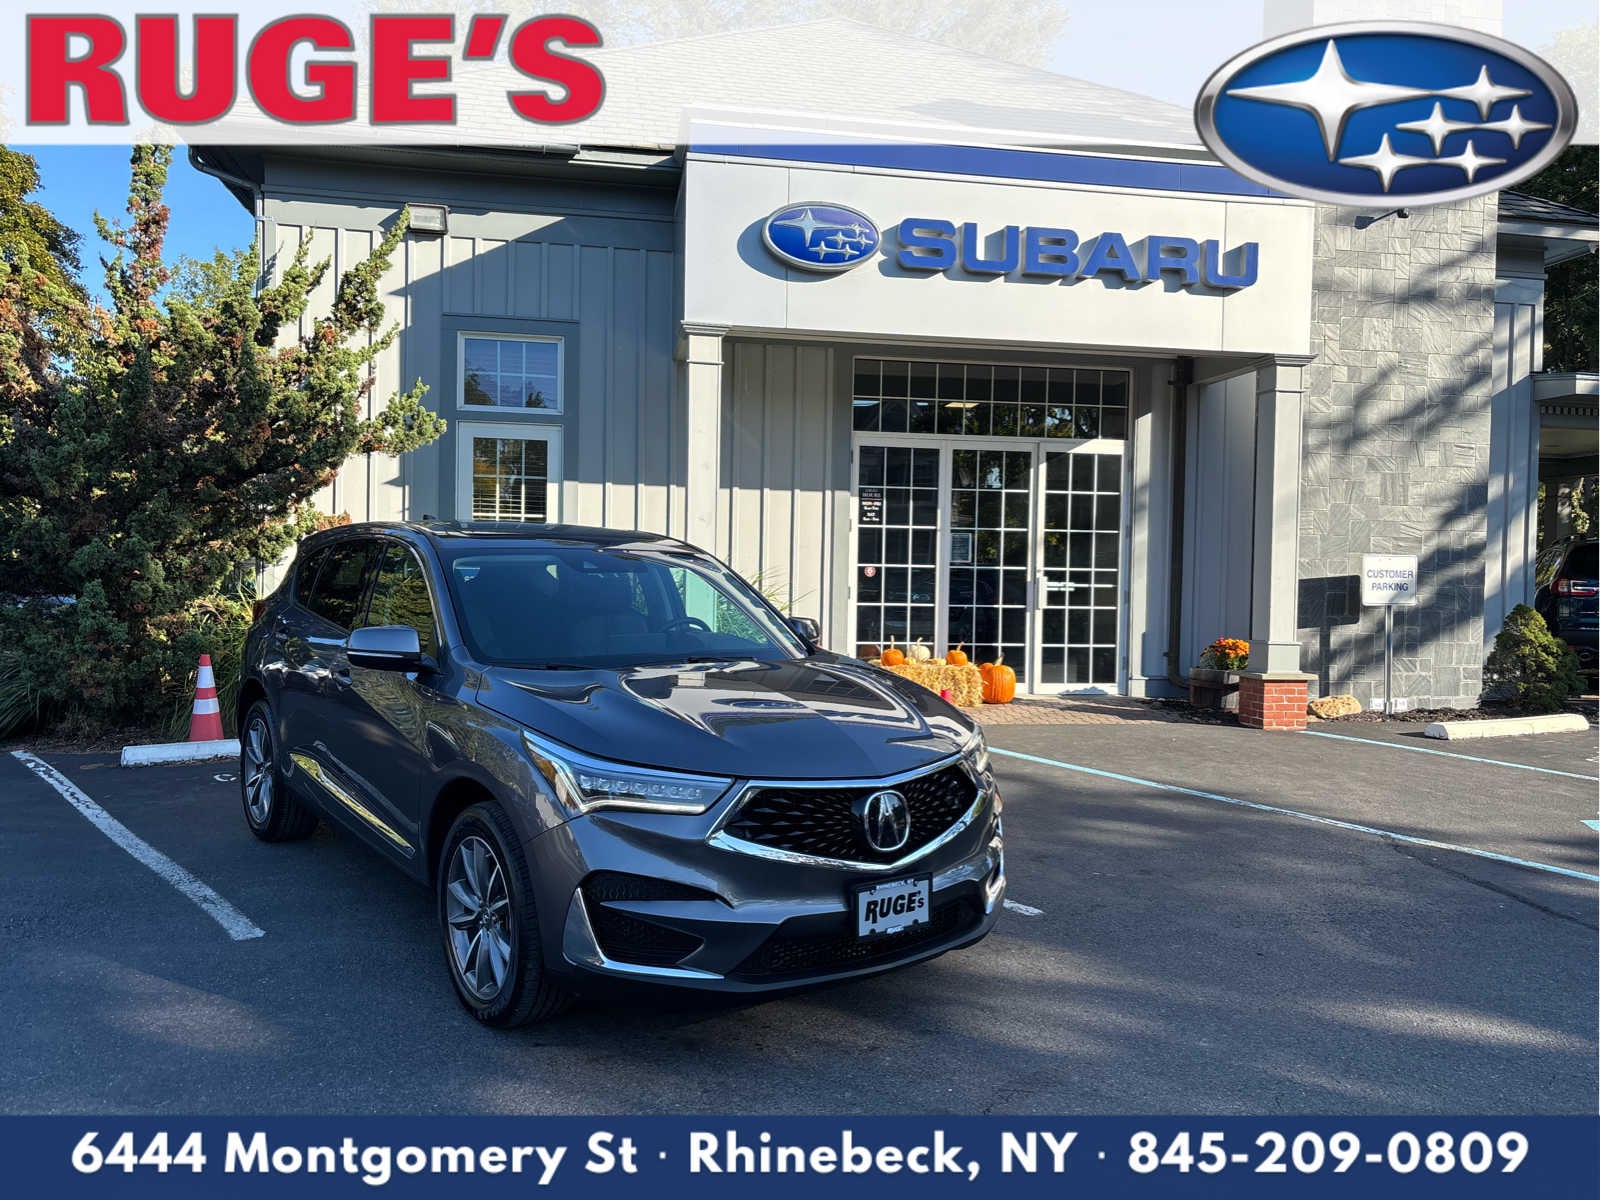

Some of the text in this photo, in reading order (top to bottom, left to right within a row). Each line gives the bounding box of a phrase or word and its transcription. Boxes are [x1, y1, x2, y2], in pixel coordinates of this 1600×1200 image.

[899, 217, 1259, 289] SUBARU
[1366, 569, 1414, 579] CUSTOMER
[1371, 582, 1409, 592] PARKING
[864, 890, 925, 925] RUGE's
